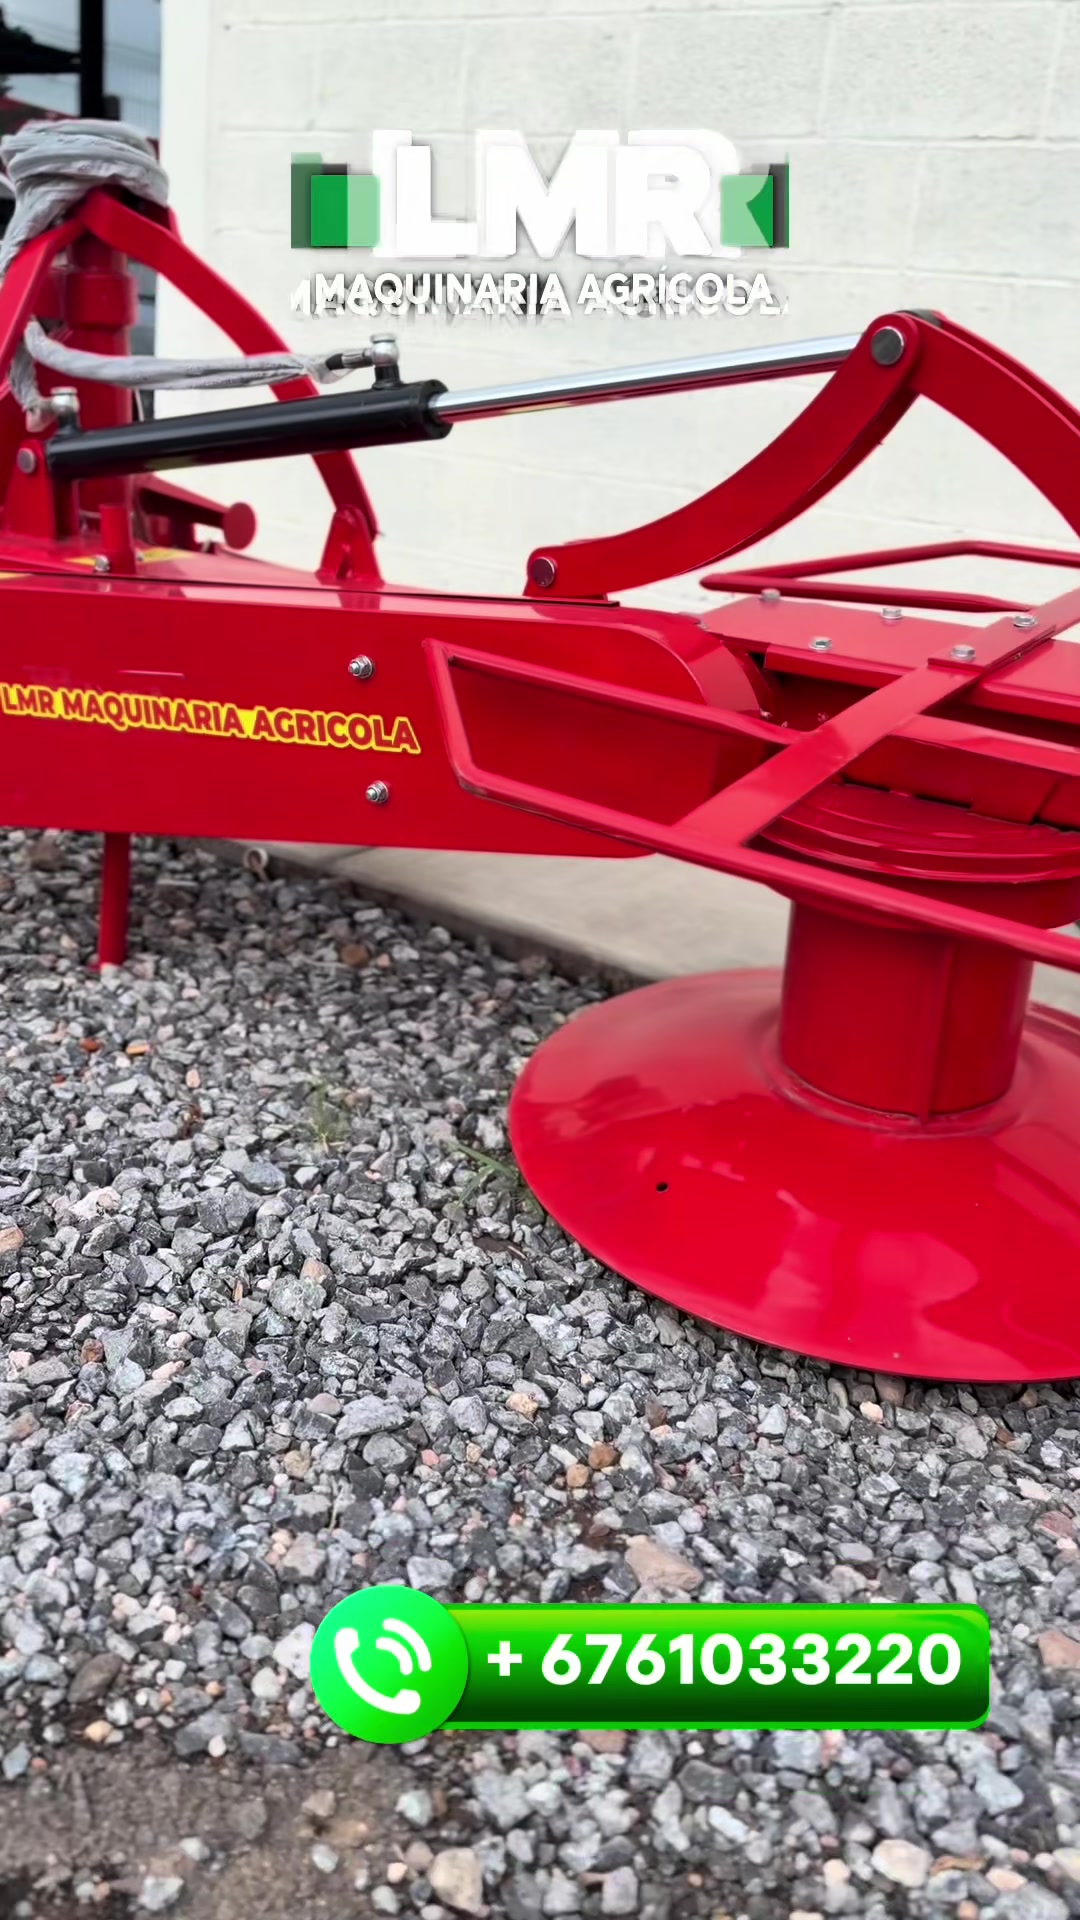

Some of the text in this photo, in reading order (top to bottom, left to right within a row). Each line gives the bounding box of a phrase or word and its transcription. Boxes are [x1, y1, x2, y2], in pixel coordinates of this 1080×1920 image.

[1, 685, 418, 751] LMR MAQUINARIA AGRICOLA
